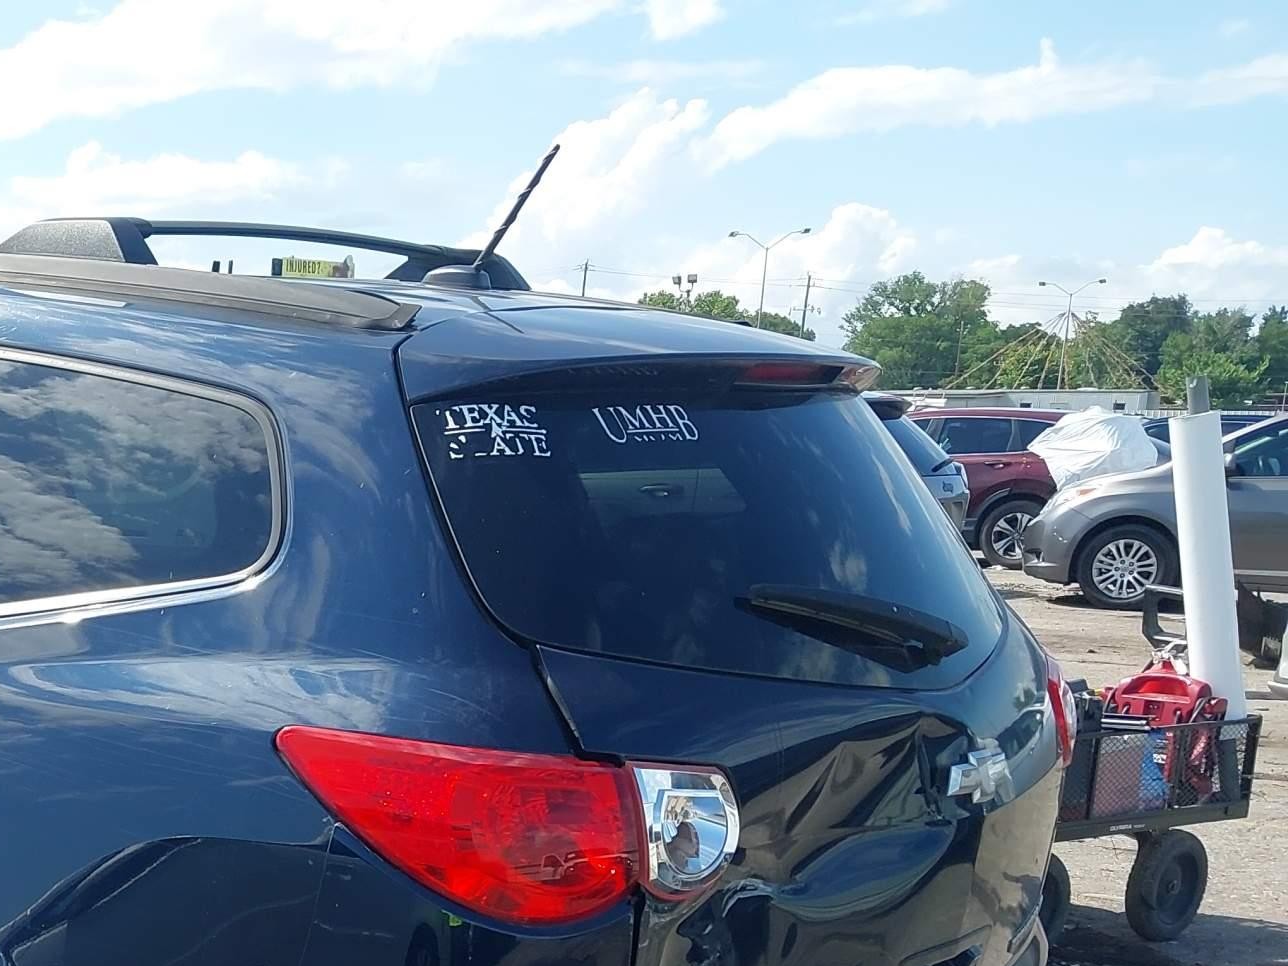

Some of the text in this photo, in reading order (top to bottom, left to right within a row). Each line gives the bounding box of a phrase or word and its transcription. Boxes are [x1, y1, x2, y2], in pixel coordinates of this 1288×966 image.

[285, 259, 321, 275] INJURED?
[435, 403, 539, 430] TEXAS
[591, 404, 700, 443] UMHB
